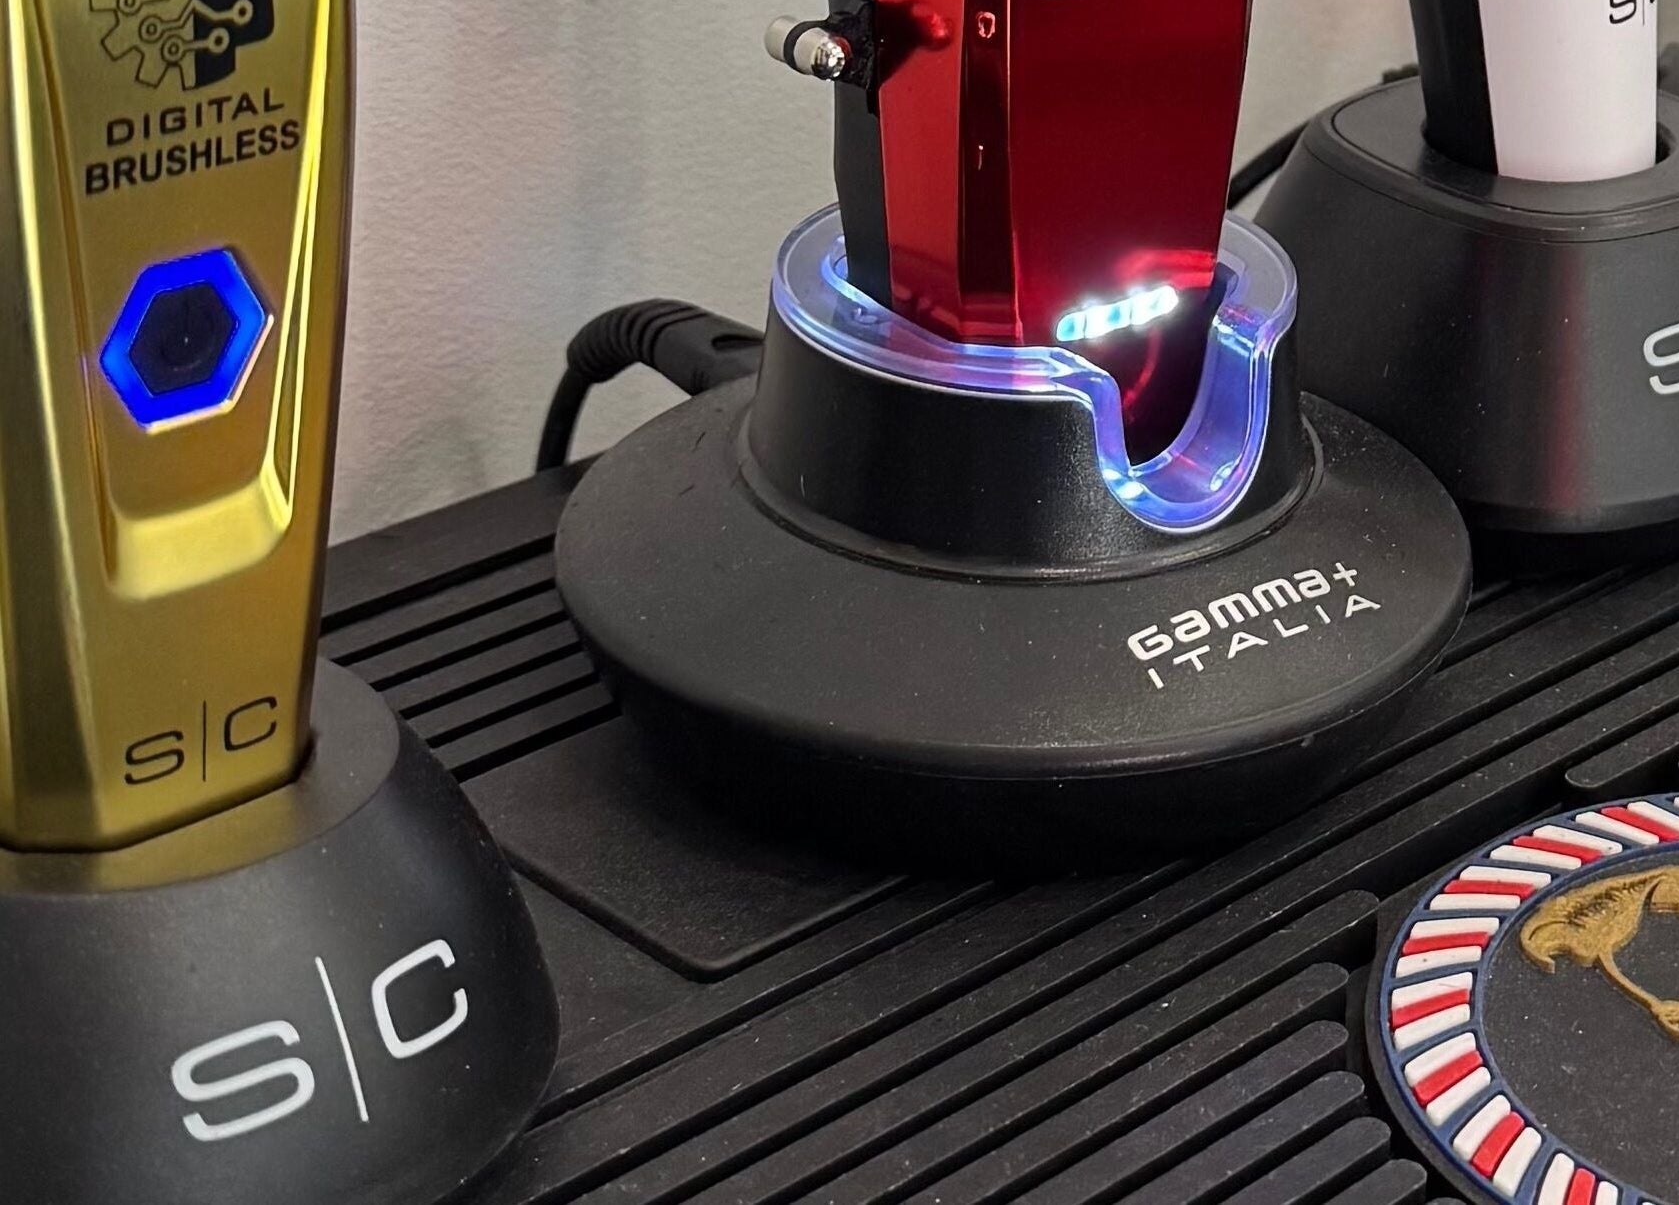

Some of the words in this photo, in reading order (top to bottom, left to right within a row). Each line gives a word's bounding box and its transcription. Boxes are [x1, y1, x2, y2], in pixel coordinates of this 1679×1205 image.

[106, 86, 286, 147] DIGITAL
[85, 120, 301, 197] BRUSHLESS
[1146, 593, 1382, 690] ITALIA
